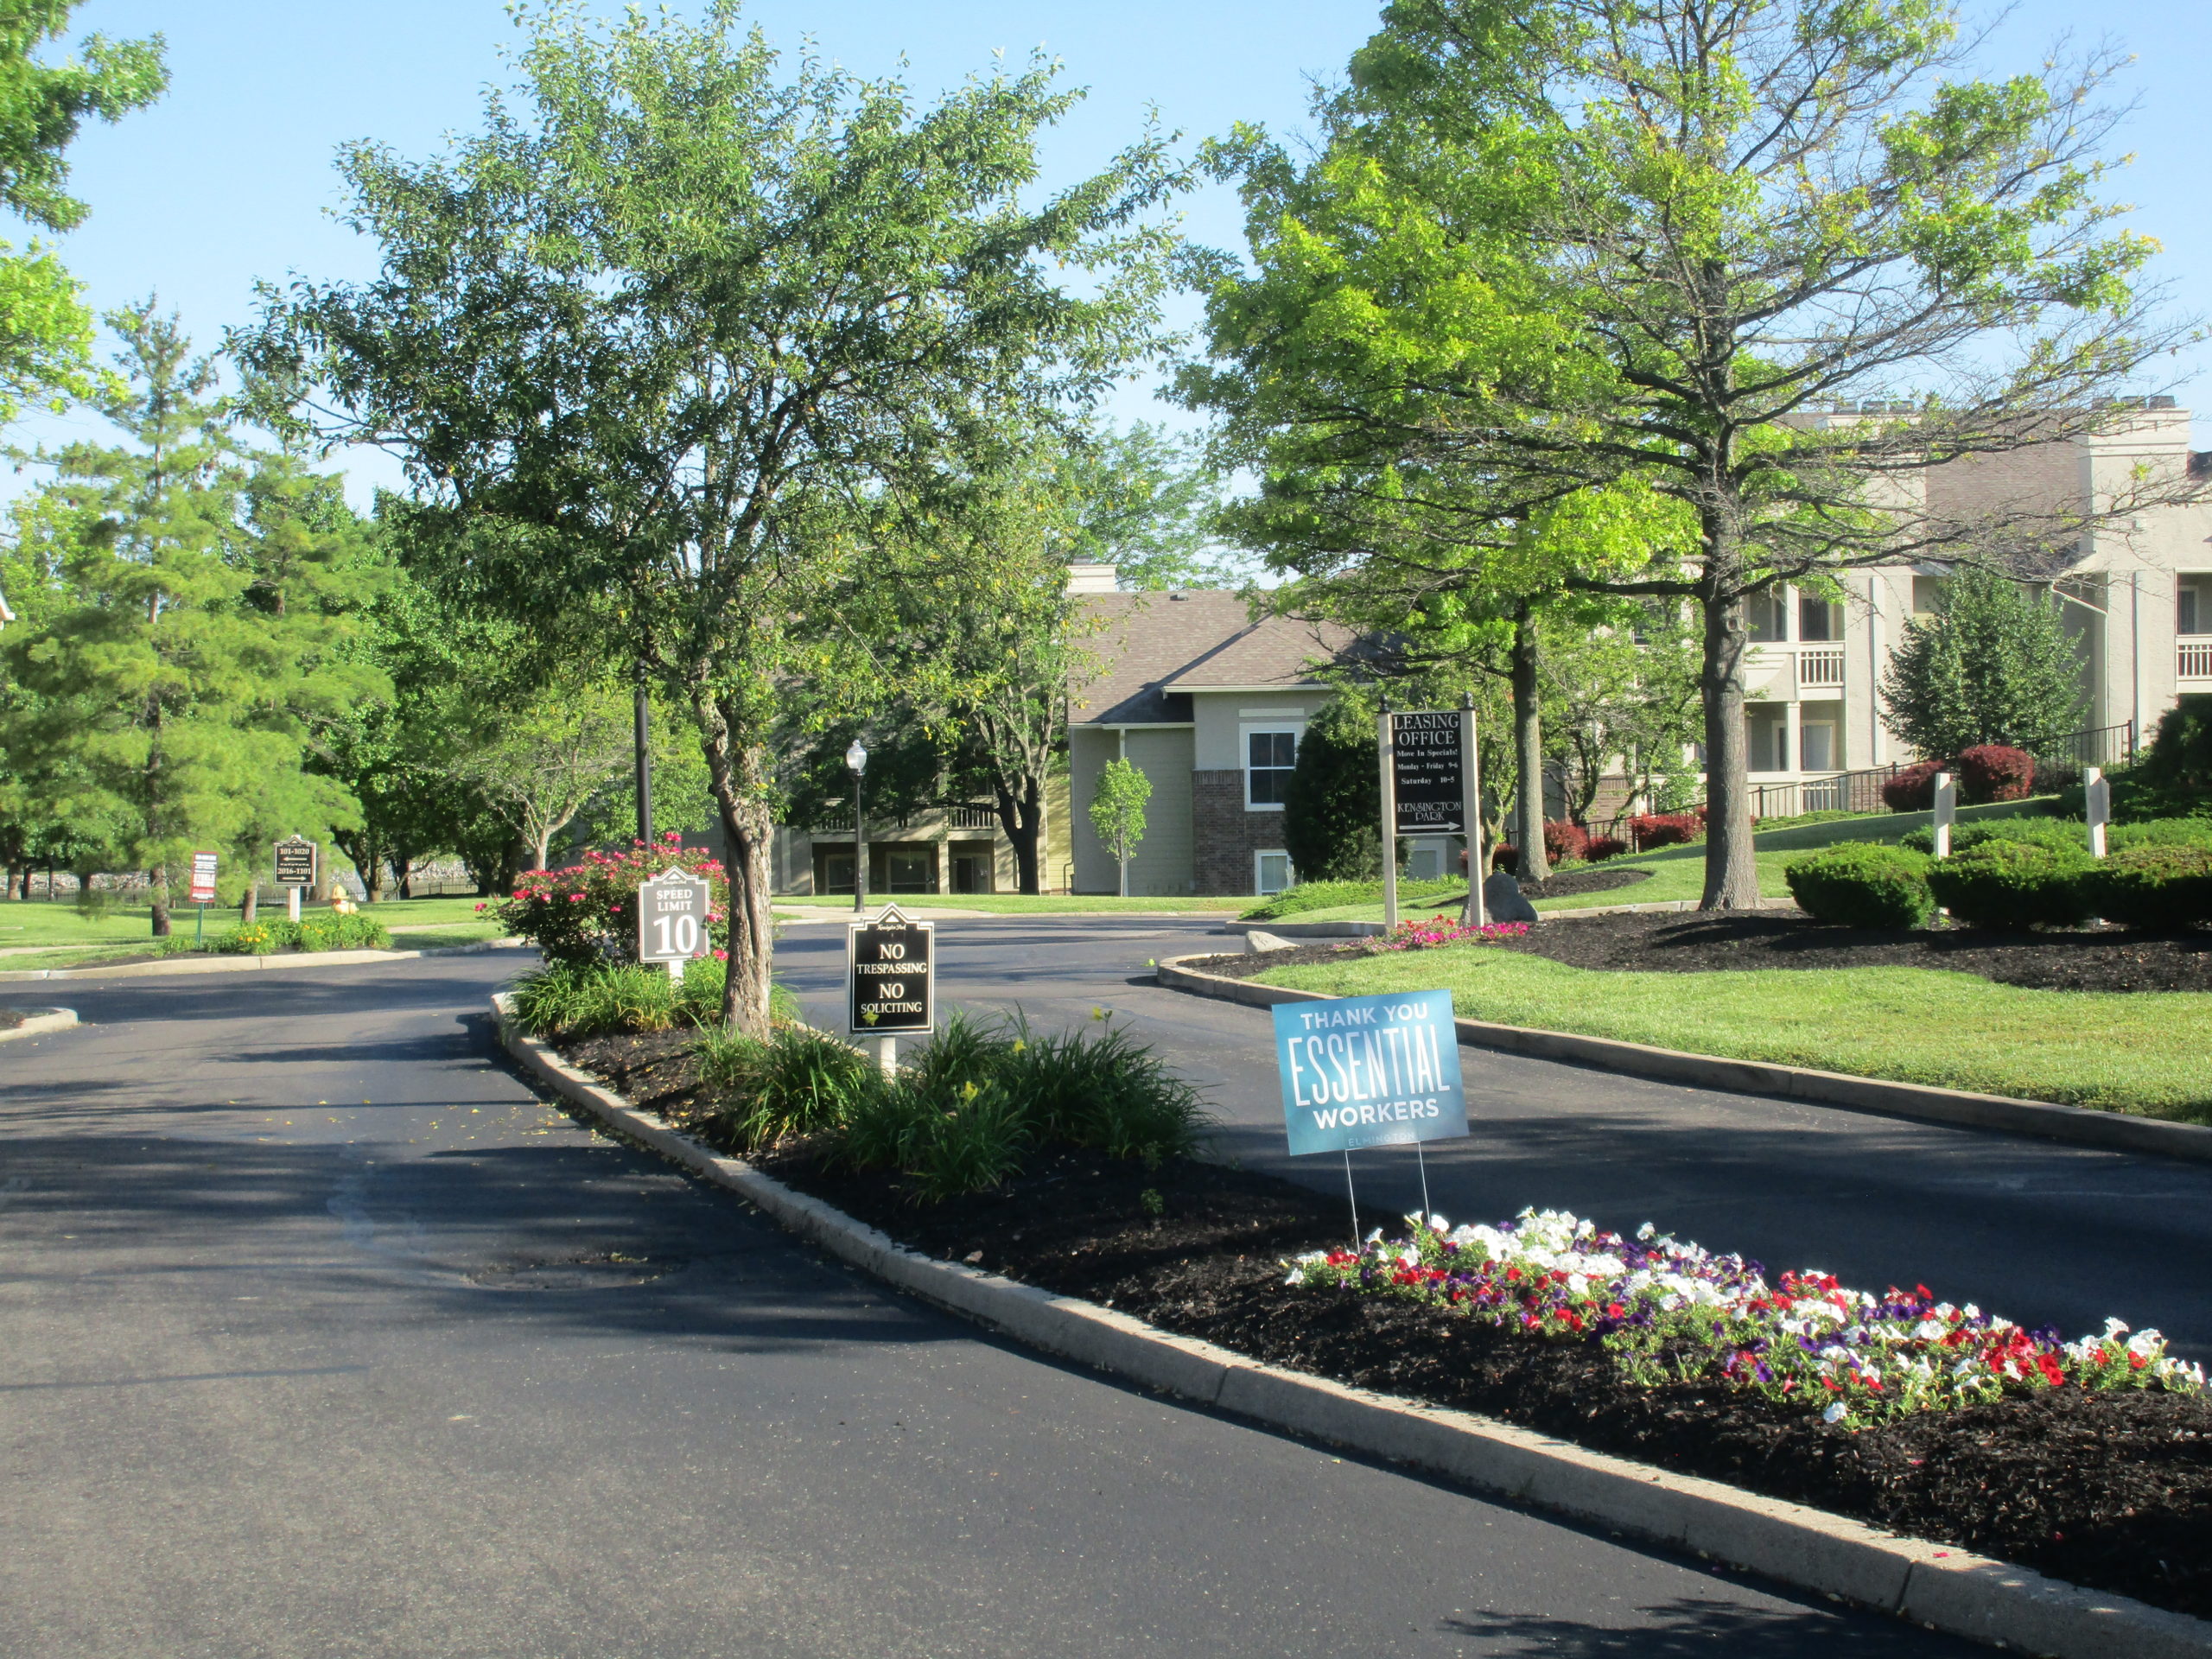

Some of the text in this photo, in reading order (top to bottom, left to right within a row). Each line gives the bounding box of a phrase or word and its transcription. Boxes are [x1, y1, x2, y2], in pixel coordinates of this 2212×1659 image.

[1394, 714, 1459, 730] LEASING
[1399, 730, 1455, 746] OFFICE
[1427, 748, 1458, 758] Specials!
[1401, 777, 1432, 785] Saturday
[1397, 801, 1462, 813] KENSINGTON
[1415, 811, 1444, 822] PARK
[656, 889, 693, 899] SPEED
[657, 901, 693, 912] LIMIT
[653, 914, 698, 954] 10
[880, 944, 905, 960] NO
[856, 963, 927, 975] TRESPASSING
[879, 982, 905, 999] NO
[861, 1001, 922, 1014] SOLICITING
[1300, 1002, 1428, 1031] THANK YOU
[1287, 1023, 1451, 1107] ESSENTIAL
[1313, 1097, 1440, 1129] WORKERS
[1348, 1132, 1415, 1147] ELMINGTON
